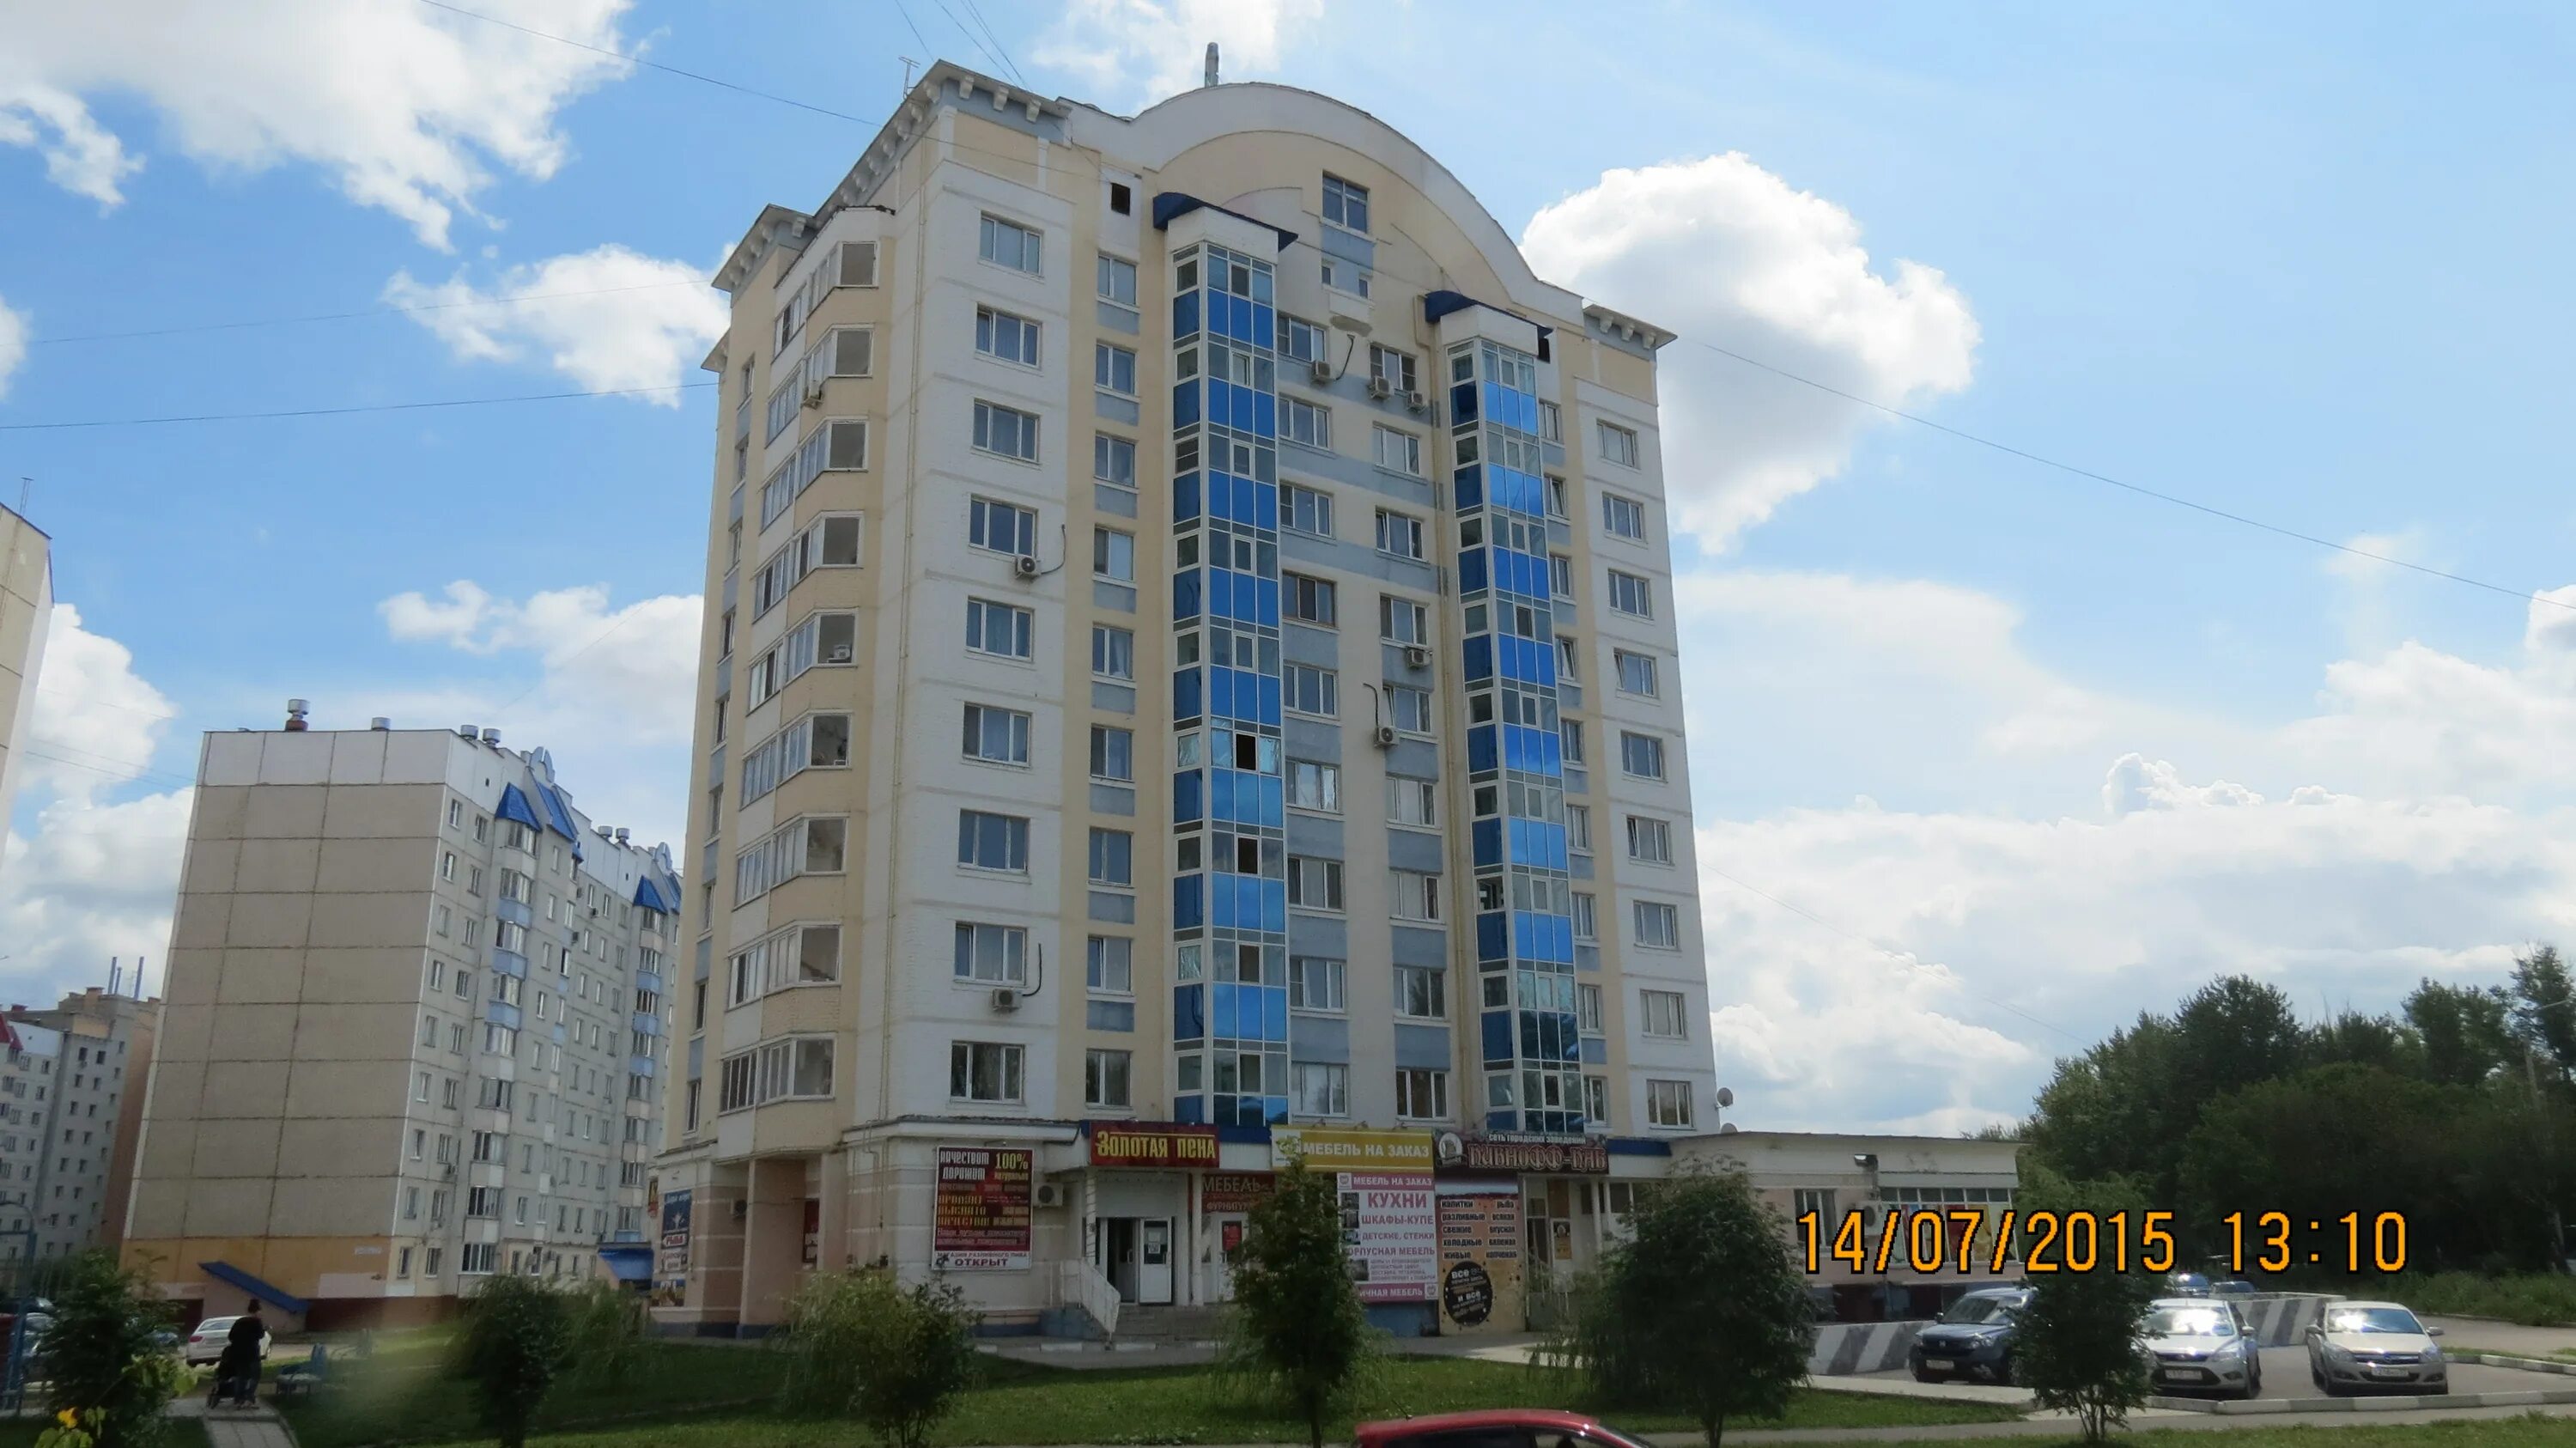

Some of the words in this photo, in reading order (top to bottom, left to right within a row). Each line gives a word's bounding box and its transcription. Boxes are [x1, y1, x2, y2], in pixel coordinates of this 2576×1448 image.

[1303, 1142, 1360, 1156] МЕБЕЛЬ
[1365, 1144, 1384, 1157] НА
[1388, 1145, 1429, 1157] ЗАКАЗ
[996, 1153, 1029, 1170] 100%
[1202, 1176, 1261, 1193] МЕБЕЛЬ
[1368, 1192, 1426, 1208] КУХНИ
[1361, 1215, 1434, 1225] ШКАФЫ-КУПЕ
[1346, 1247, 1396, 1256] ОРПУСНАЯ
